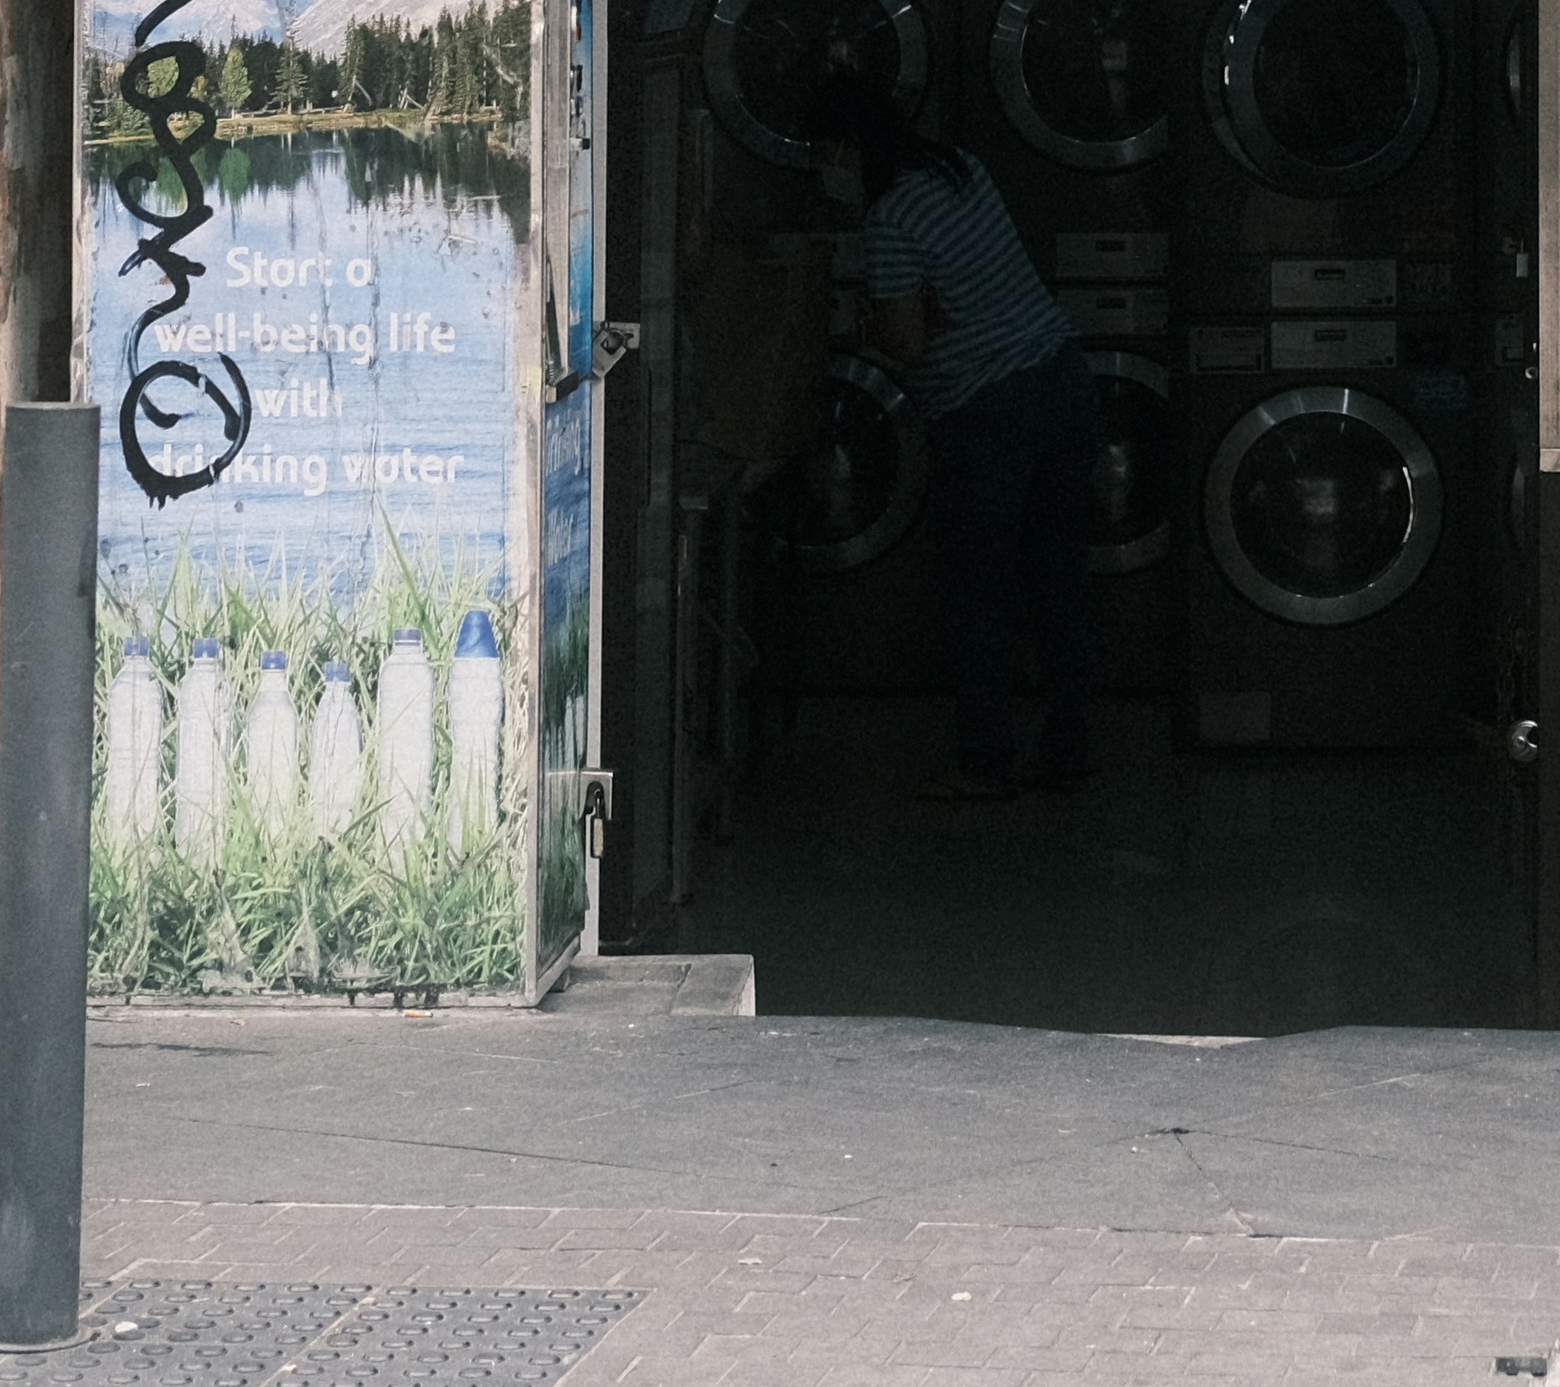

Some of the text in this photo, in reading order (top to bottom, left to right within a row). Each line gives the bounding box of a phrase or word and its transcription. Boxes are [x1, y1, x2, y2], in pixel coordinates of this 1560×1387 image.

[225, 246, 374, 287] Start a
[153, 312, 456, 366] well-being life
[254, 377, 344, 418] with
[341, 447, 465, 484] water
